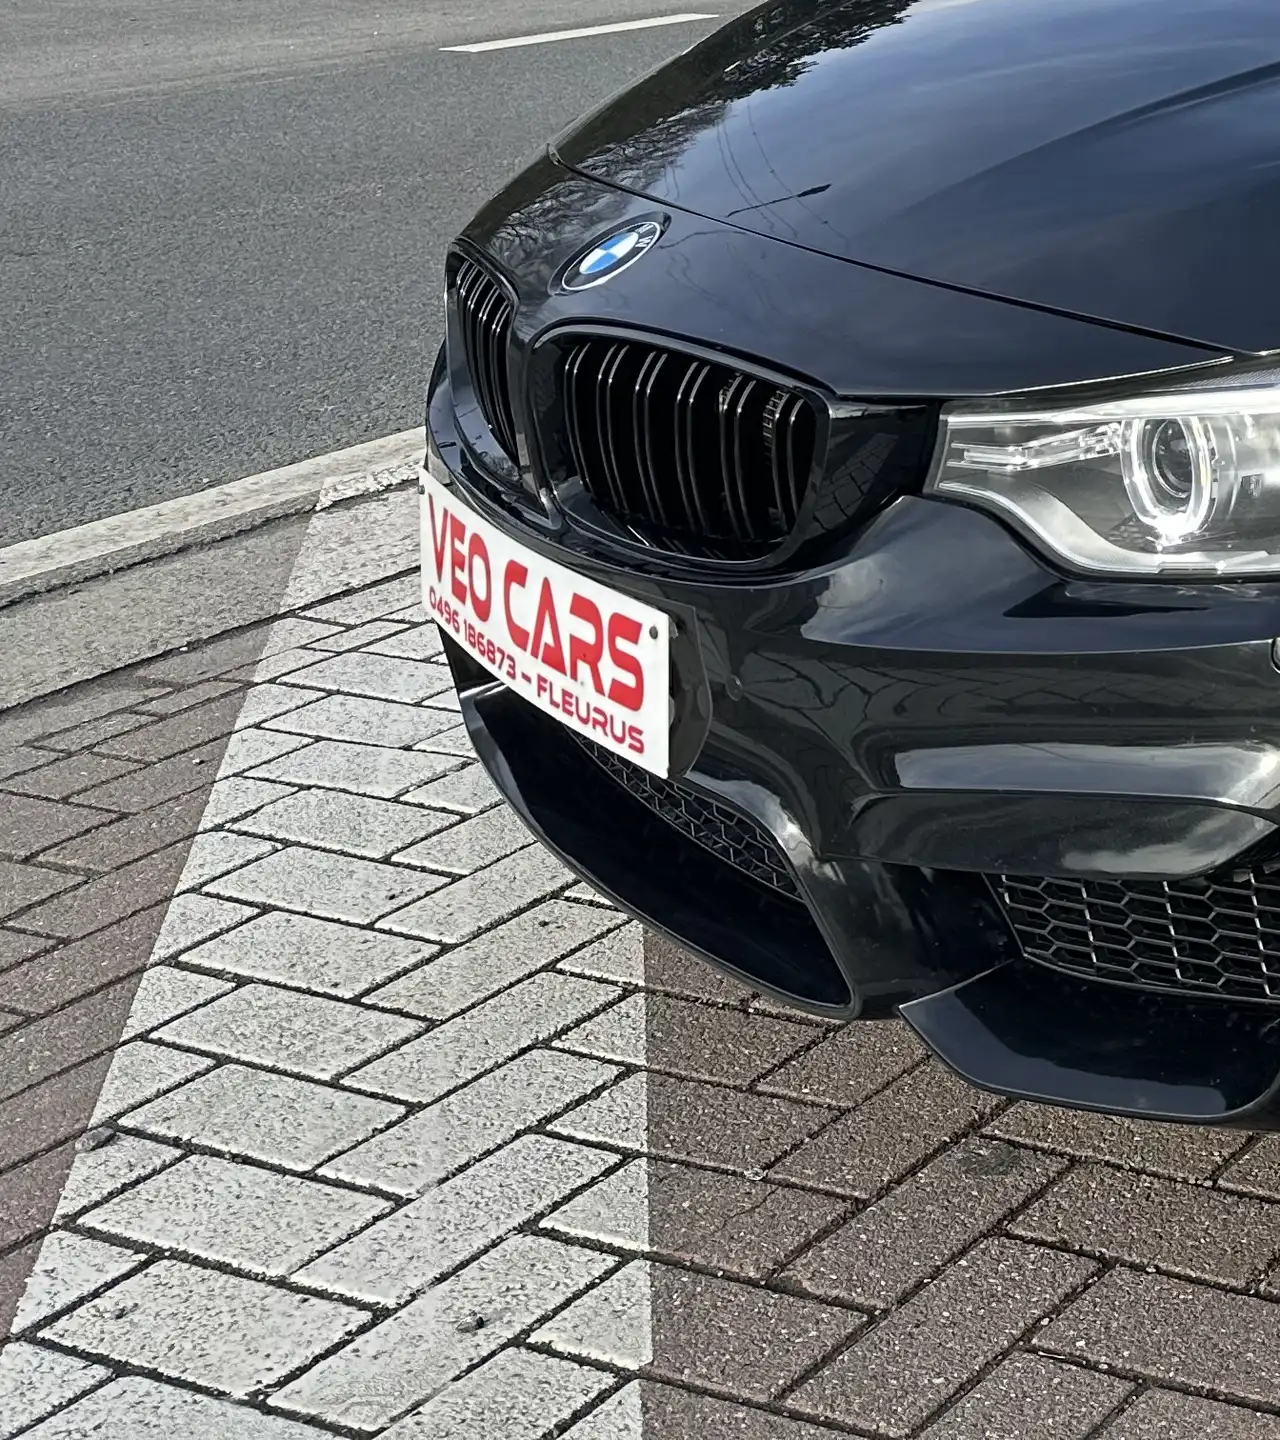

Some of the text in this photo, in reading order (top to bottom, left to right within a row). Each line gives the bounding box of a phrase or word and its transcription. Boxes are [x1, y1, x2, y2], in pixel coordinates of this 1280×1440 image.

[428, 492, 645, 712] VEO CARS
[428, 585, 460, 633] 0496
[463, 620, 517, 680] 186873
[536, 674, 645, 754] FLEURUS
